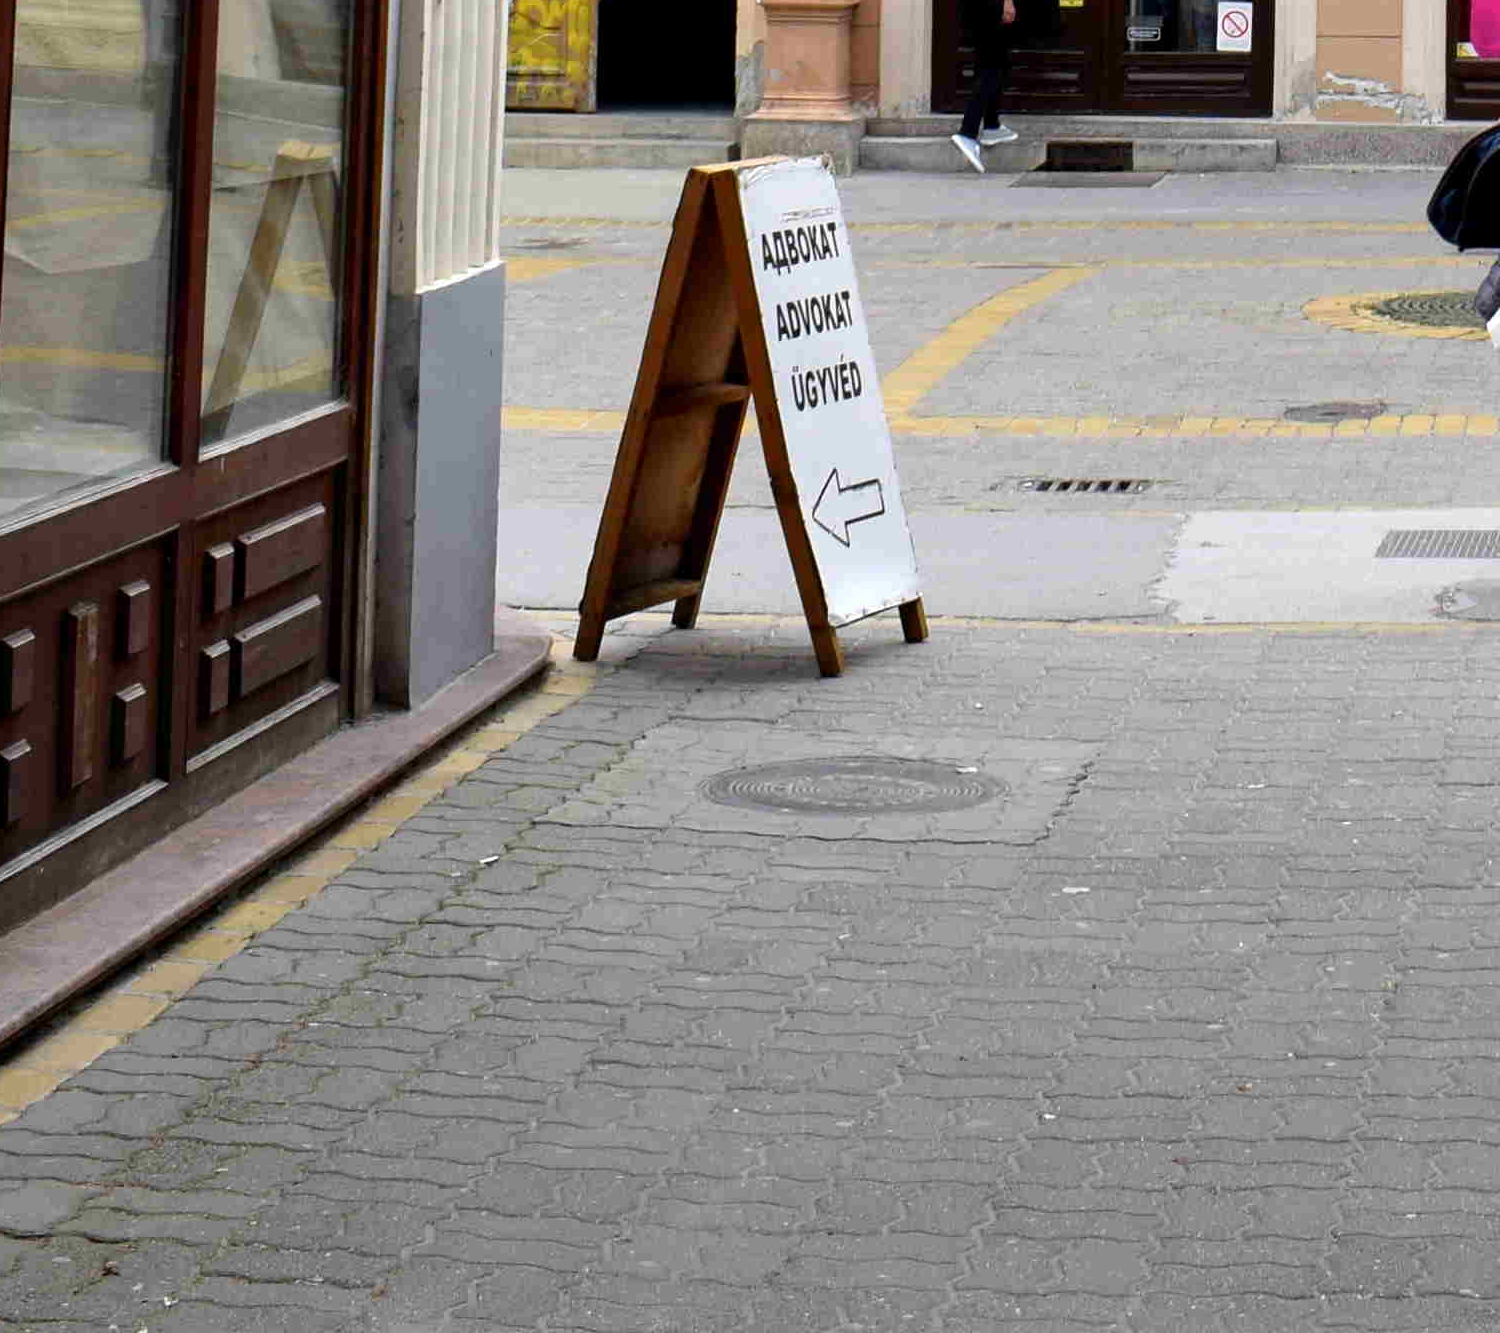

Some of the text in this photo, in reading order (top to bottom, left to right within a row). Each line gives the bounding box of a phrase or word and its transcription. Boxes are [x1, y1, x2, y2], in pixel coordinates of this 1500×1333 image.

[761, 221, 839, 276] АДВОКАТ
[776, 290, 853, 342] ADVOKAT
[790, 354, 863, 412] ÜGYVÉD
